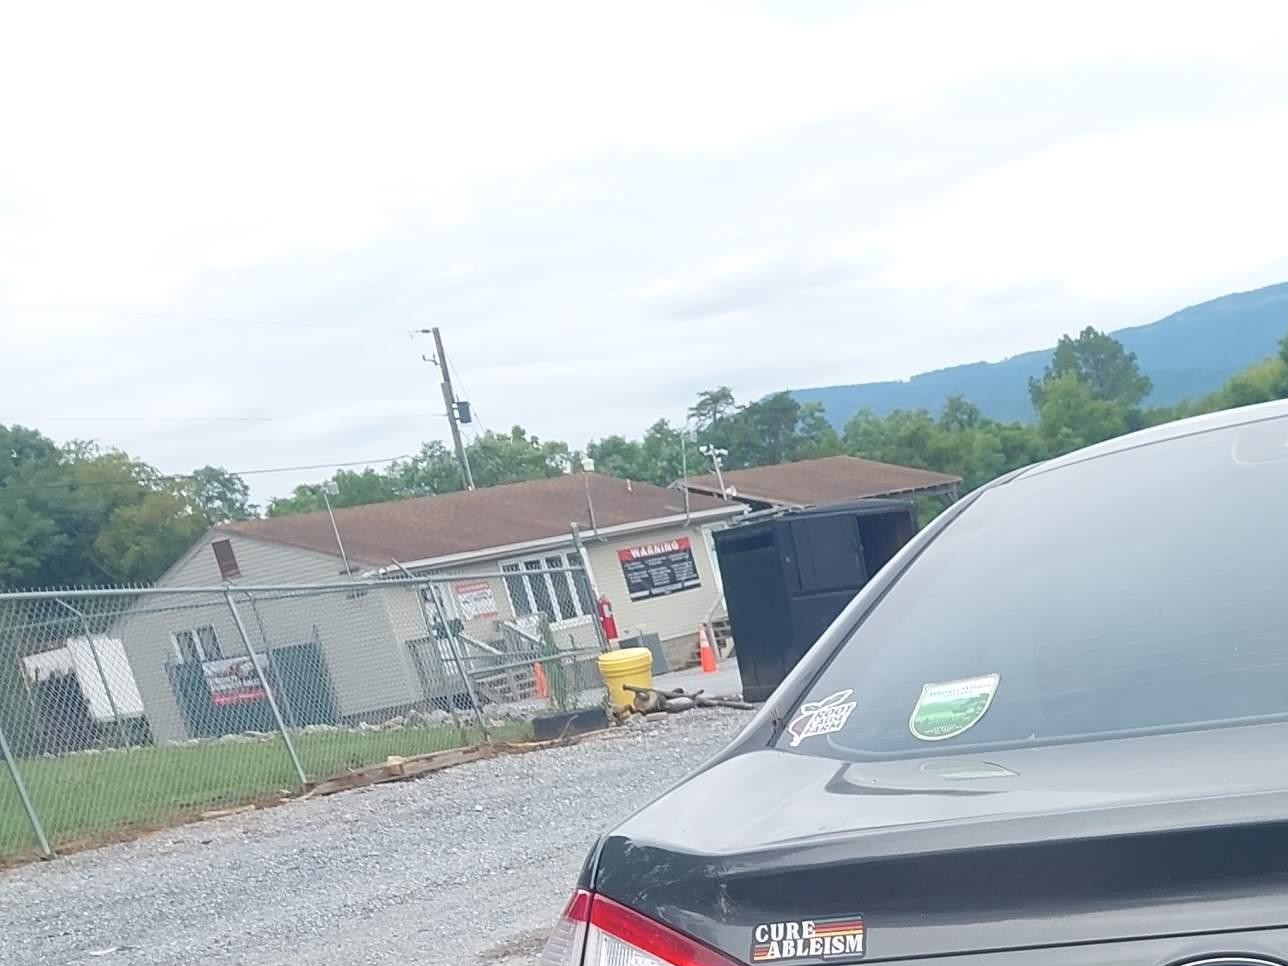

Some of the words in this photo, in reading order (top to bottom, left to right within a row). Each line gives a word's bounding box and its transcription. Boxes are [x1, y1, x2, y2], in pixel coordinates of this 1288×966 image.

[630, 540, 679, 558] WARNING
[755, 920, 816, 942] CURE
[767, 934, 863, 958] ABLEISM
